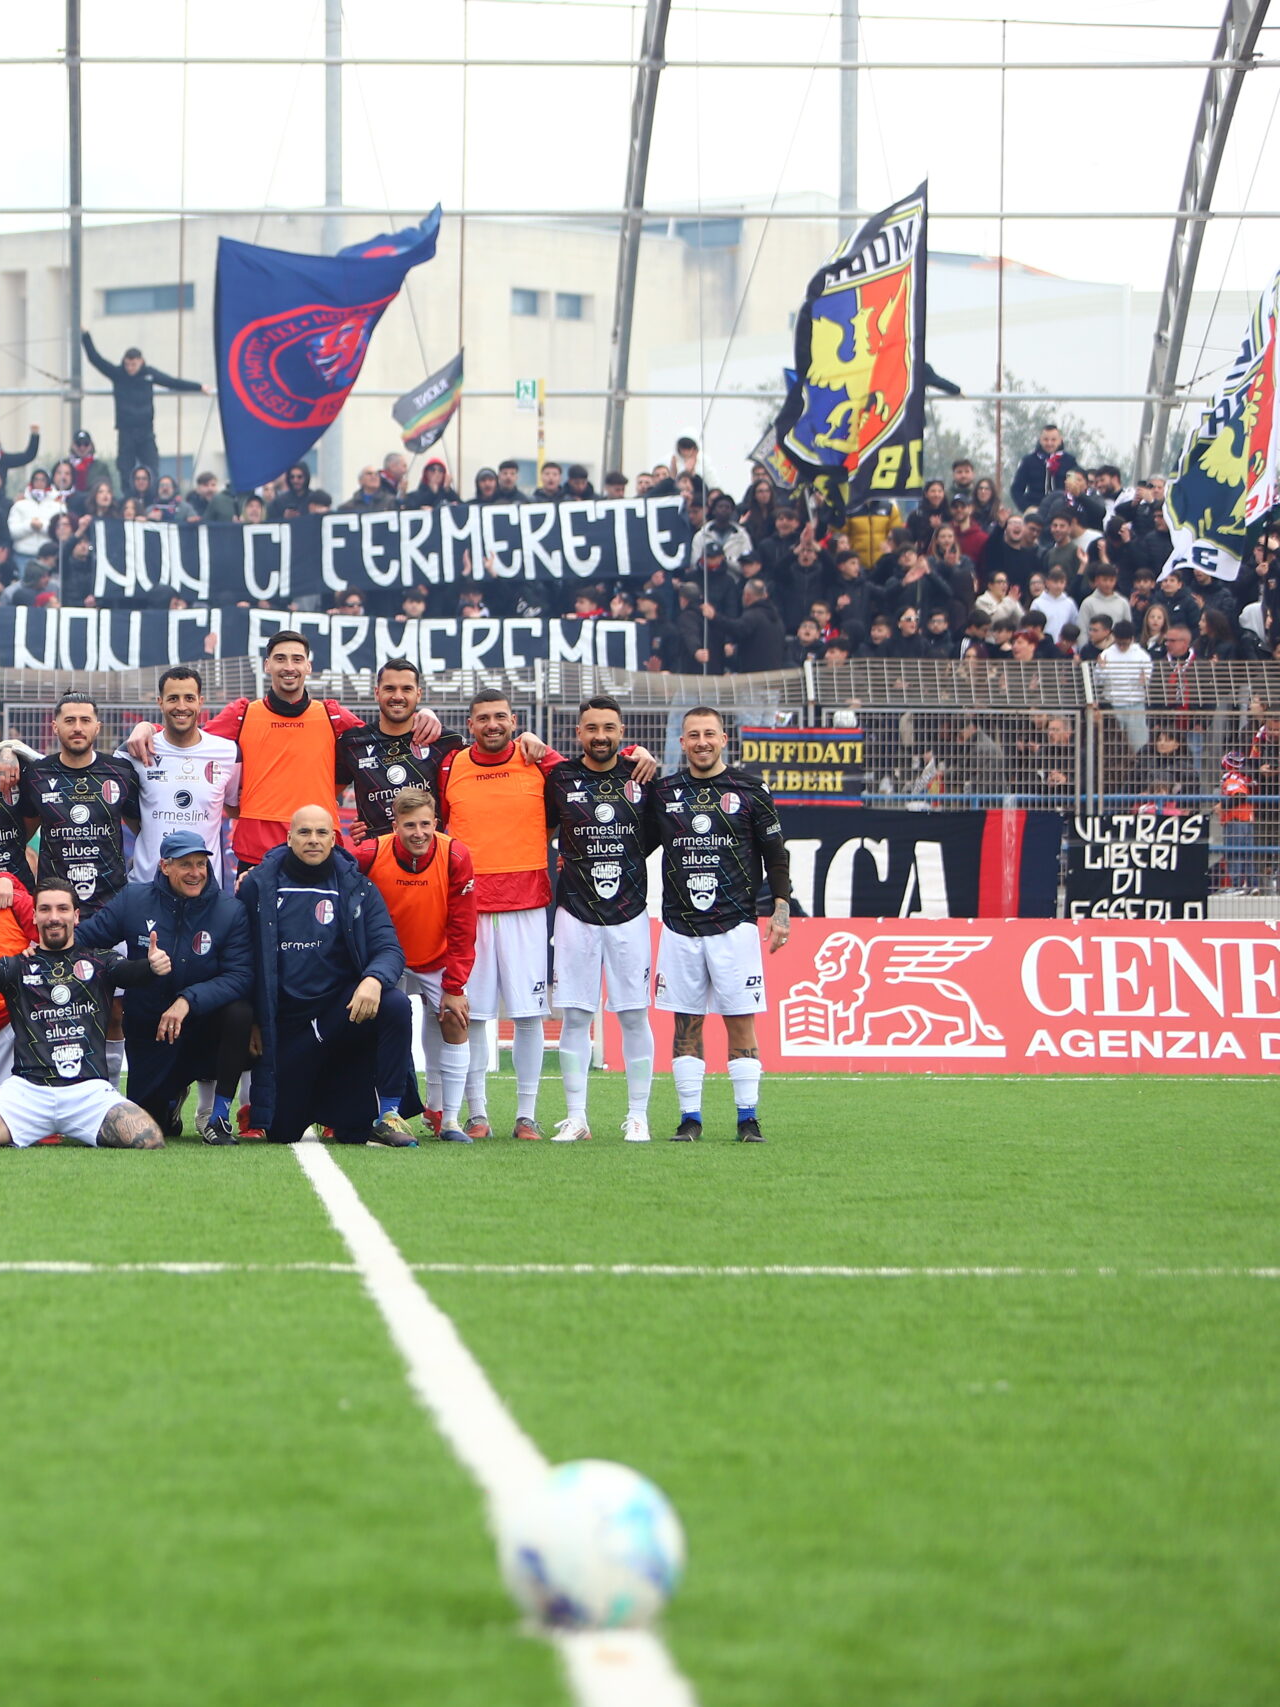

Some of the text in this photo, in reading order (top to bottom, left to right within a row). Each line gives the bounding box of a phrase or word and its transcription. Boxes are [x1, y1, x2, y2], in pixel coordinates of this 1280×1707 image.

[93, 495, 686, 599] NON CI FERMERETE
[14, 605, 141, 673] NON
[169, 608, 222, 684] CI
[270, 721, 305, 729] macron
[741, 741, 864, 764] DIFFIDATI
[476, 771, 510, 781] macron
[763, 769, 844, 792] LIBERI
[152, 810, 210, 821] ermeslink
[50, 824, 111, 837] ermeslink
[573, 823, 635, 836] ermeslink
[1075, 814, 1203, 844] ULTRAS
[586, 840, 624, 854] siluce
[672, 834, 734, 847] ermeslink
[62, 843, 100, 857] siluce
[1084, 844, 1177, 870] LIBERI
[682, 851, 721, 865] siluce
[67, 867, 98, 881] BOMBER
[591, 864, 622, 879] BOMBER
[396, 879, 428, 887] macron
[686, 876, 719, 891] BOMBER
[1112, 869, 1142, 895] DI
[30, 1001, 95, 1021] ermeslink
[45, 1024, 85, 1039] siluce
[1025, 1029, 1246, 1060] AGENZIA
[52, 1047, 83, 1061] BOMBER
